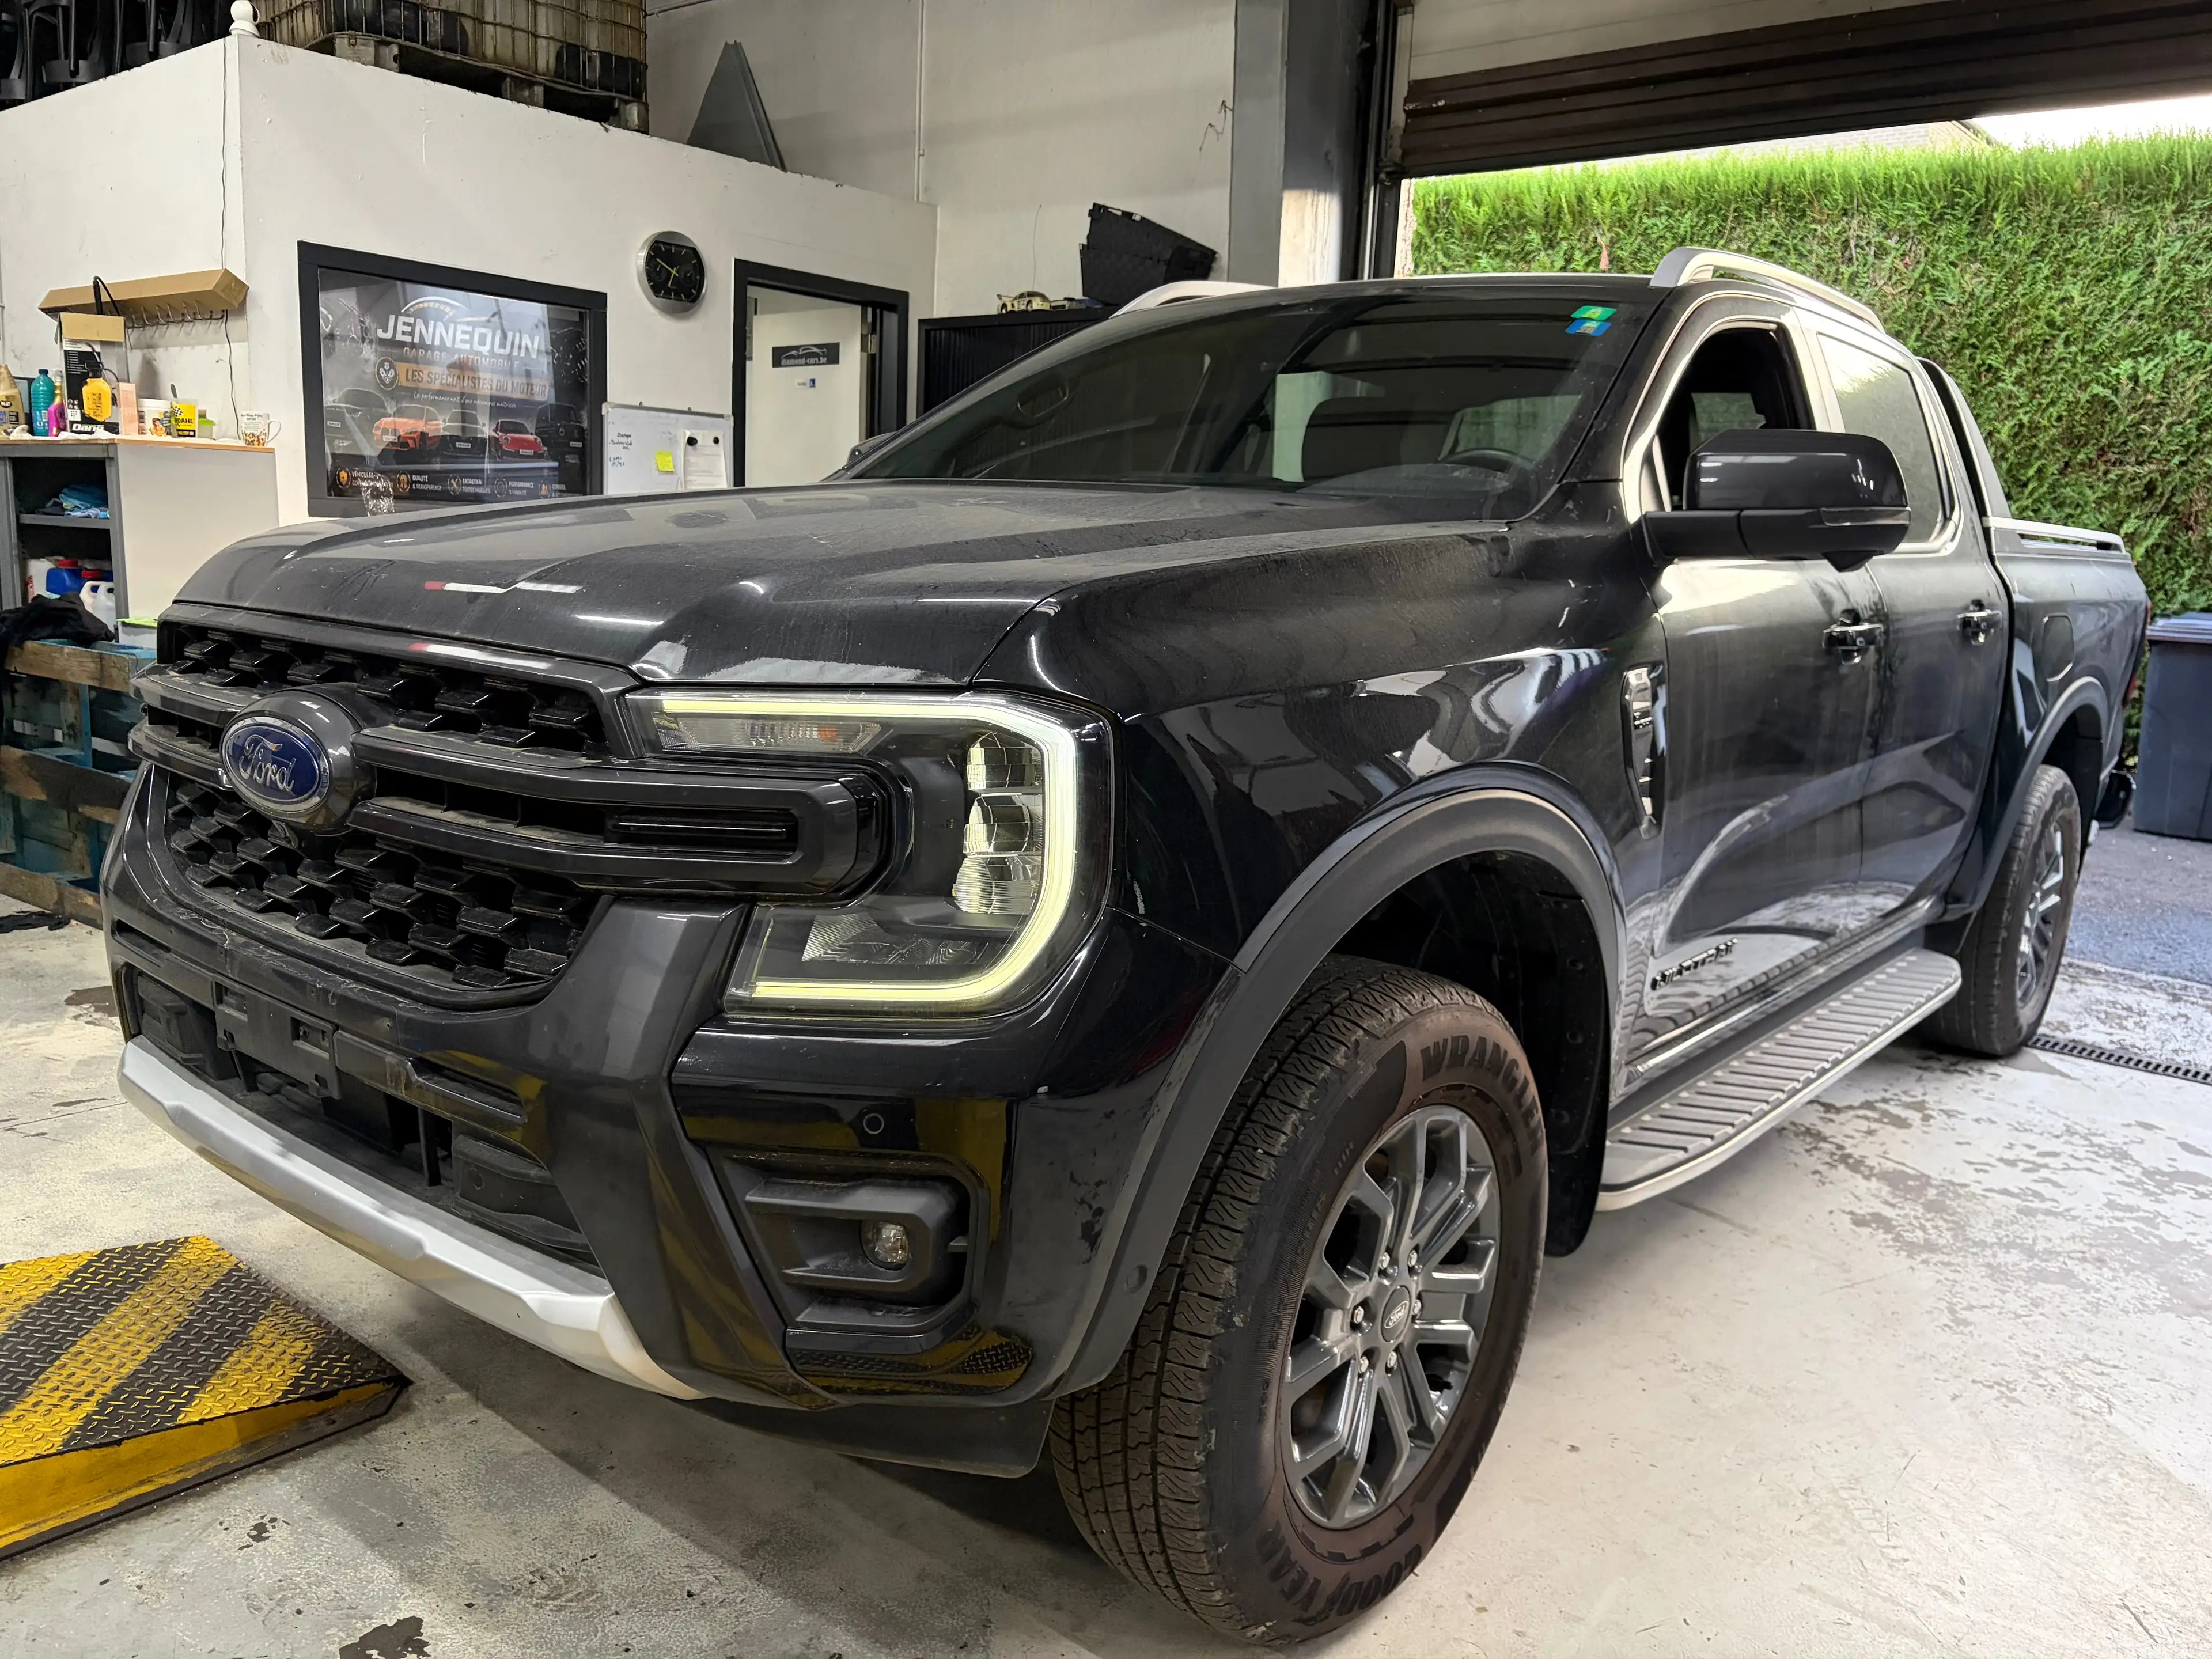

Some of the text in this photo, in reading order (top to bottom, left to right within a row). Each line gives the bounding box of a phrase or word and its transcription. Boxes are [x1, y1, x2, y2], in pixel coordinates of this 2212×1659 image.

[377, 314, 539, 359] JENNEQUIN
[403, 347, 520, 369] GARAGE AUTOMOBILE
[405, 368, 547, 397] LES SPÉCIALISTES DU MOTEUR
[239, 734, 296, 791] Ford
[1421, 1035, 1544, 1156] WRANGLER
[1255, 1520, 1422, 1627] GOODYEAR
